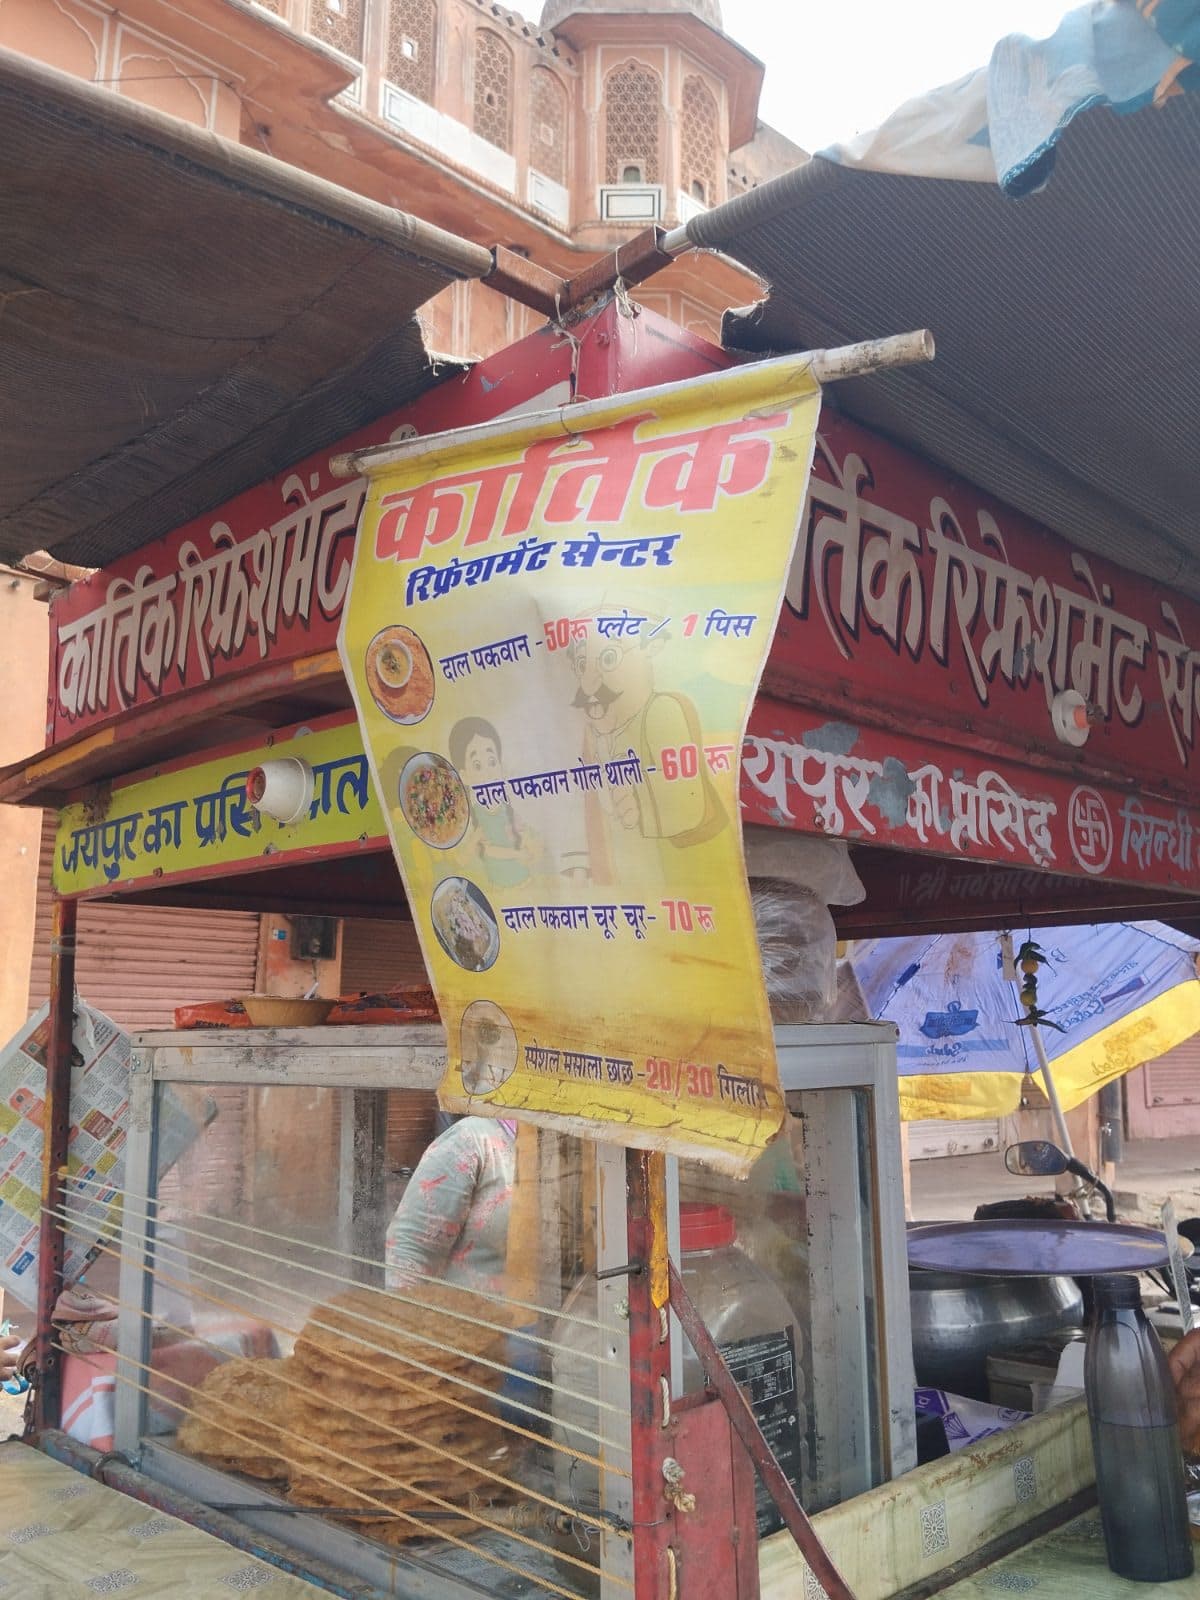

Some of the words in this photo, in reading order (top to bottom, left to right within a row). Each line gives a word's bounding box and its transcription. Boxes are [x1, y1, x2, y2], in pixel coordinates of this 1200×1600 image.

[374, 412, 787, 562] कार्तिक
[406, 537, 556, 606] रिफ्रेशमेंट
[561, 532, 680, 567] सेन्टर
[58, 565, 177, 714] कार्तिक
[439, 652, 471, 682] दाल
[471, 634, 531, 670] पकवान
[597, 610, 646, 638] प्लेट
[682, 614, 698, 637] 1
[704, 609, 757, 638] पिस
[1154, 600, 1200, 767] से
[143, 801, 188, 854] का
[194, 771, 284, 847] प्रसि
[472, 780, 508, 809] दाल
[509, 770, 570, 799] पकवान
[571, 757, 602, 792] गोल
[605, 749, 643, 786] थाली
[661, 745, 698, 780] 60
[741, 735, 883, 835] यपुर
[502, 905, 535, 933] दाल
[538, 905, 589, 930] पकवान
[592, 904, 617, 938] चूर
[662, 901, 692, 932] 70
[525, 1038, 560, 1072] स्पेशल
[563, 1052, 602, 1080] मसाला
[605, 1058, 633, 1084] छाछ
